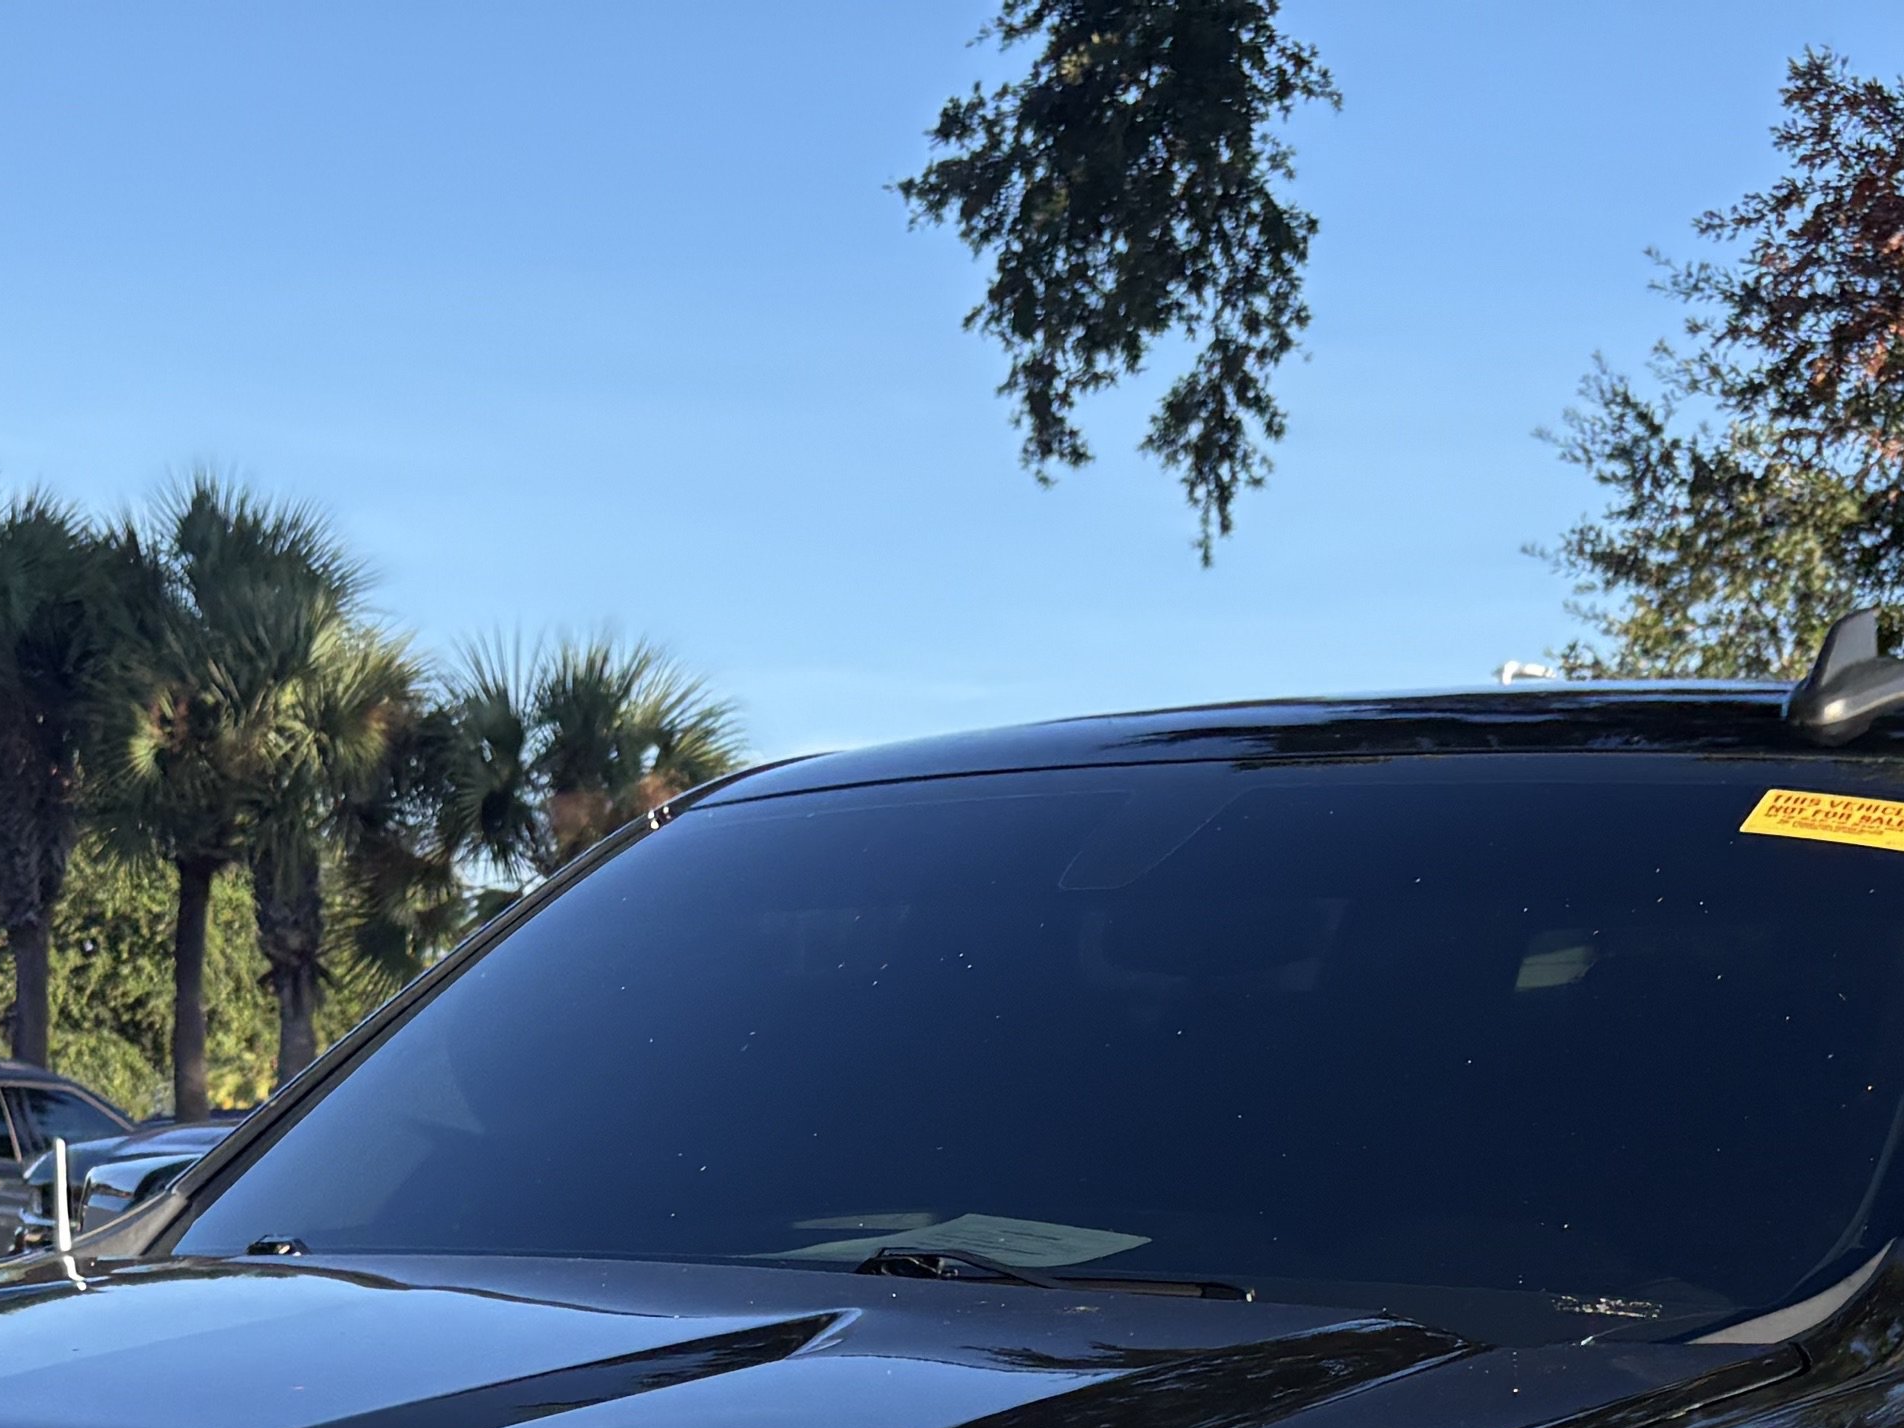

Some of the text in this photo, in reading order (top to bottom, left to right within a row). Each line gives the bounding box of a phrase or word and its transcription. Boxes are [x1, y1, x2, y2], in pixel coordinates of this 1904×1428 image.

[1772, 794, 1821, 807] THIS
[1768, 804, 1804, 816] NOT
[1811, 809, 1852, 821] FOR
